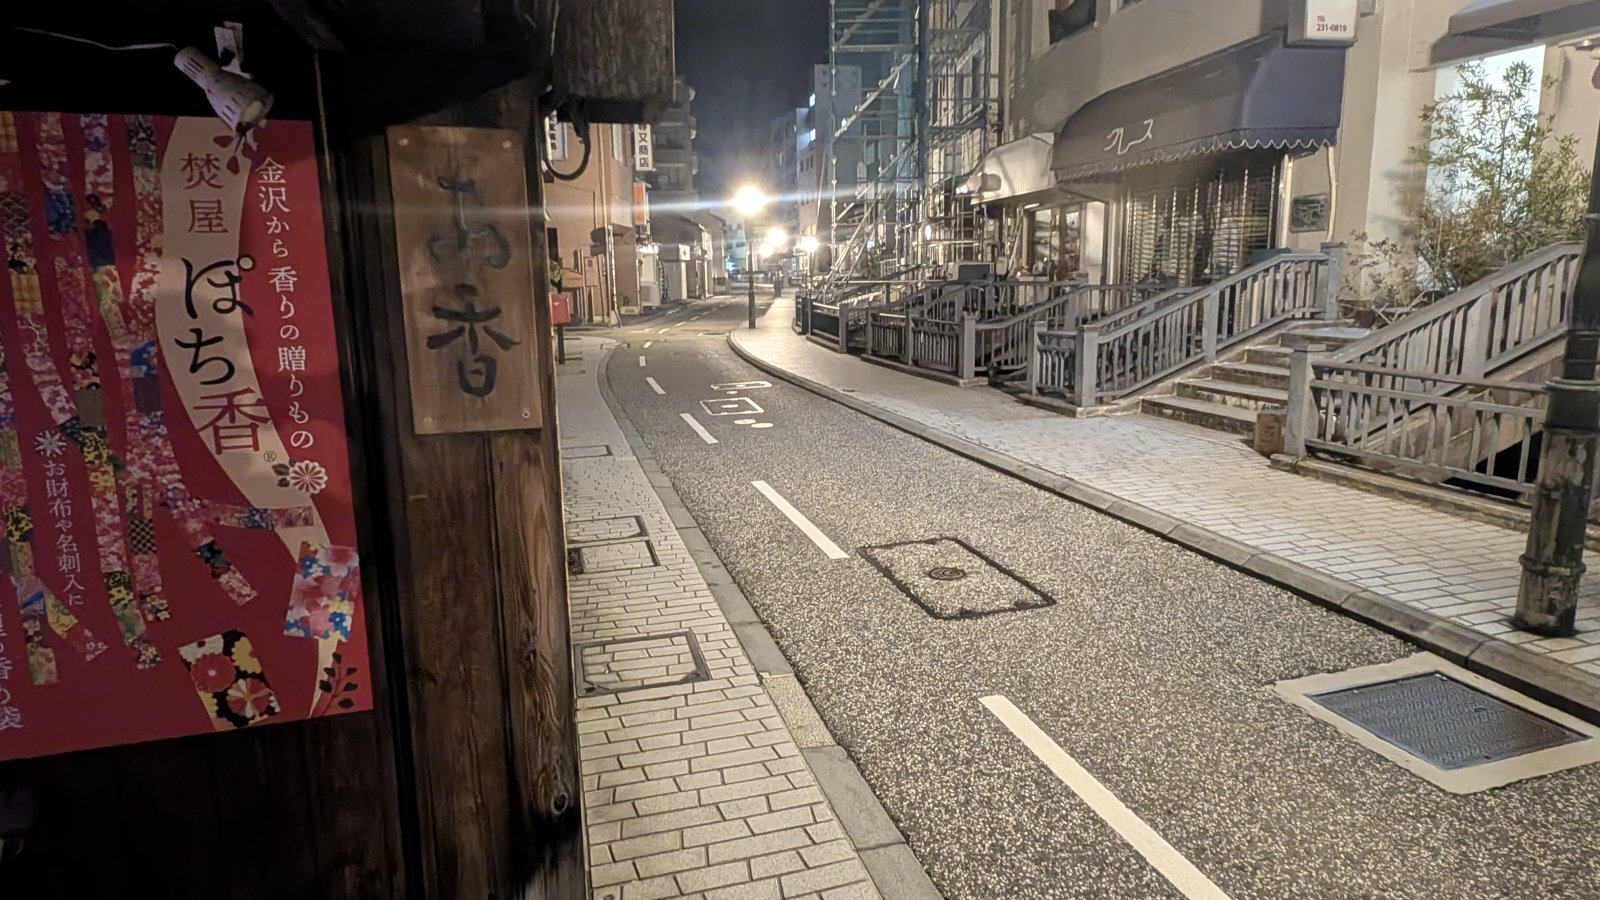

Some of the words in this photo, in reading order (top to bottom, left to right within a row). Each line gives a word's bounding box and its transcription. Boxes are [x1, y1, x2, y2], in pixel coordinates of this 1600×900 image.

[1316, 23, 1347, 32] 231-0819
[180, 152, 230, 234] 焚屋
[255, 156, 314, 449] 金沢から香りの贈りもの
[43, 460, 86, 606] お財布や名刺入に
